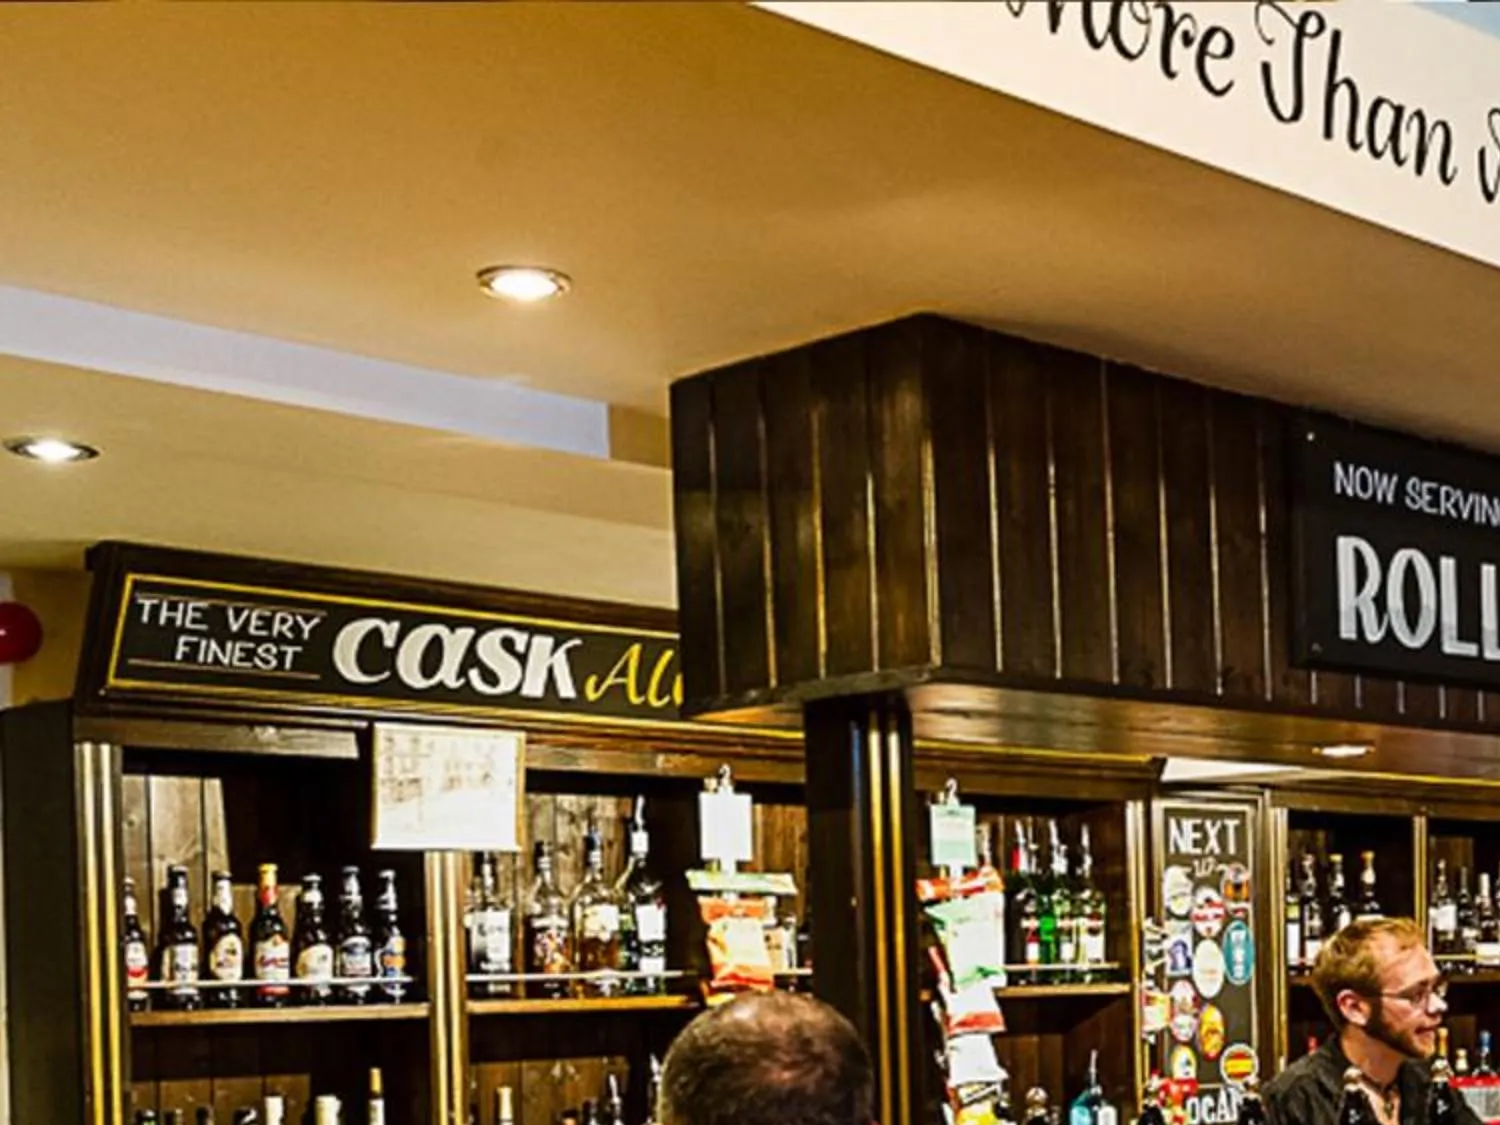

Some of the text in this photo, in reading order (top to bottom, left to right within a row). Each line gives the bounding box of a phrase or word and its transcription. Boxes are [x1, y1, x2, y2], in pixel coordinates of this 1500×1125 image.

[1255, 1, 1457, 185] Than
[1334, 461, 1399, 504] NOW
[136, 599, 322, 641] THE VERY
[175, 636, 303, 671] FINEST
[1168, 817, 1240, 855] NEXT
